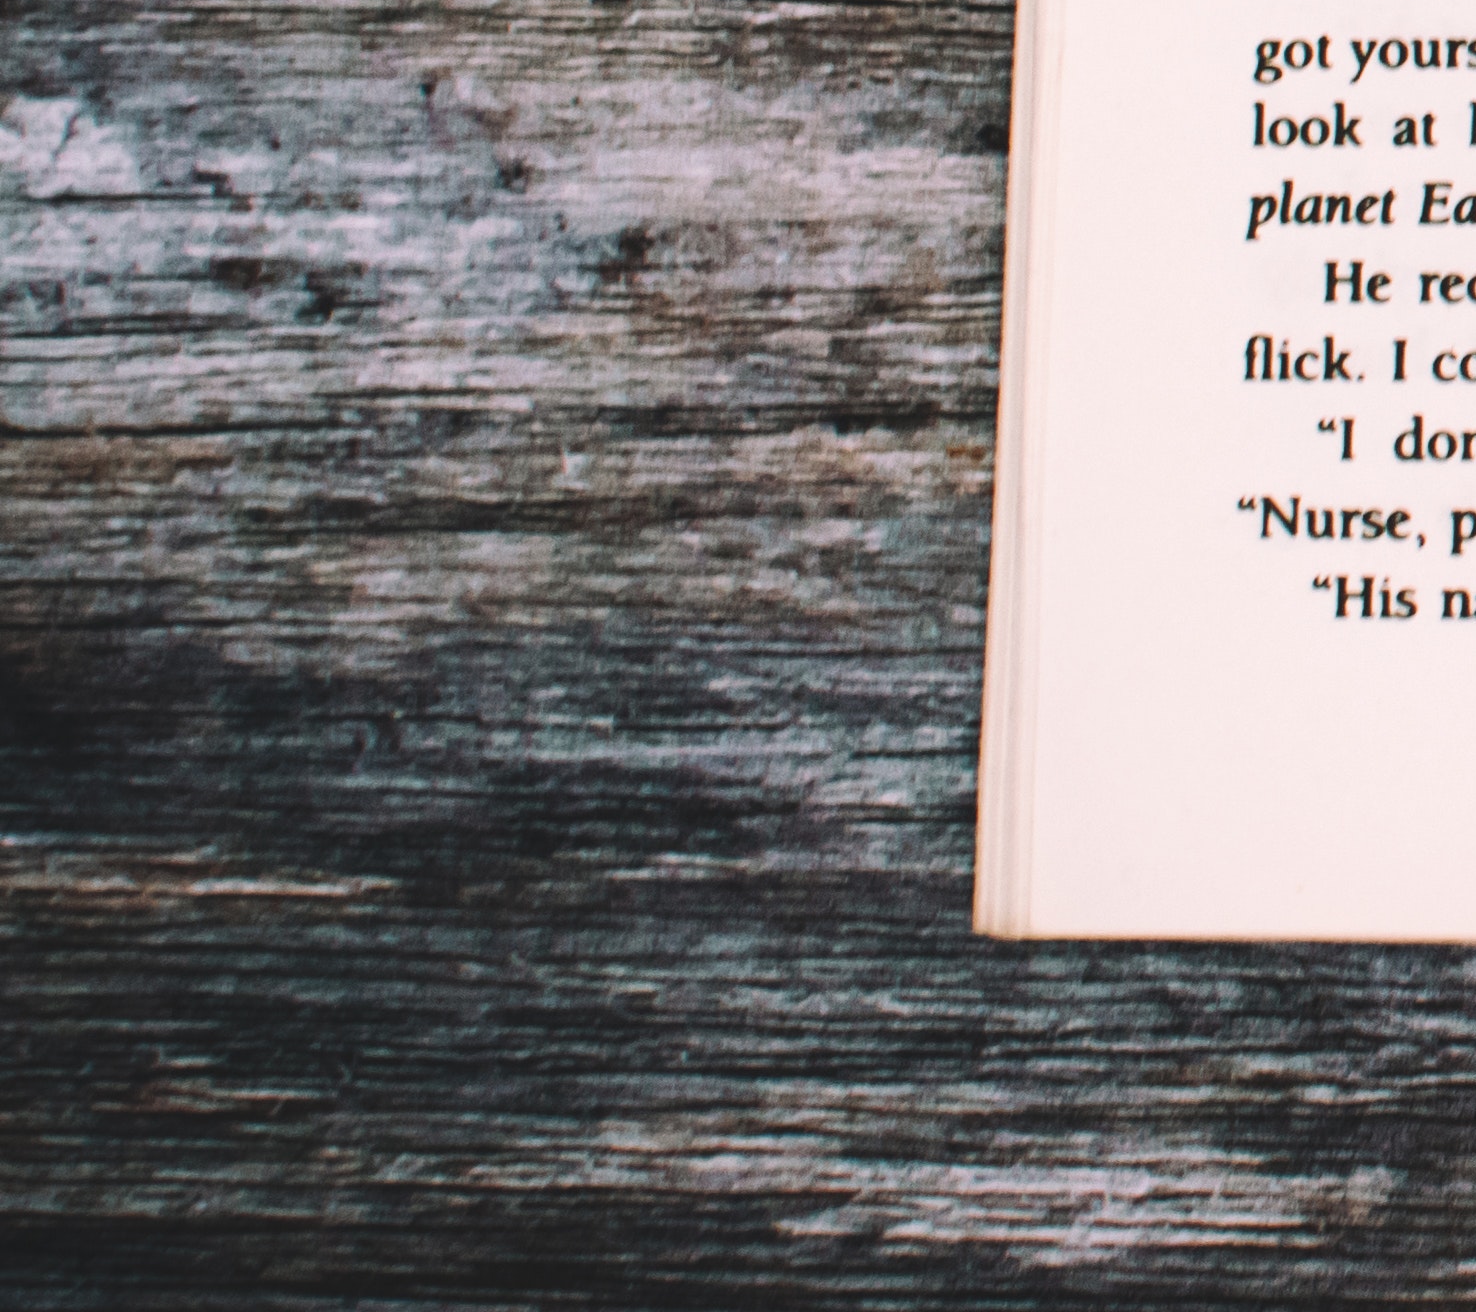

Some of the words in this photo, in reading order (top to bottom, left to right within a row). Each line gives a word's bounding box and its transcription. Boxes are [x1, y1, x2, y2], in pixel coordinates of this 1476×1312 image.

[1253, 101, 1362, 148] look
[1393, 113, 1436, 148] at
[1324, 261, 1392, 304] He
[1244, 334, 1364, 382] flick.
[1393, 339, 1407, 382] I
[1312, 575, 1417, 620] “His
